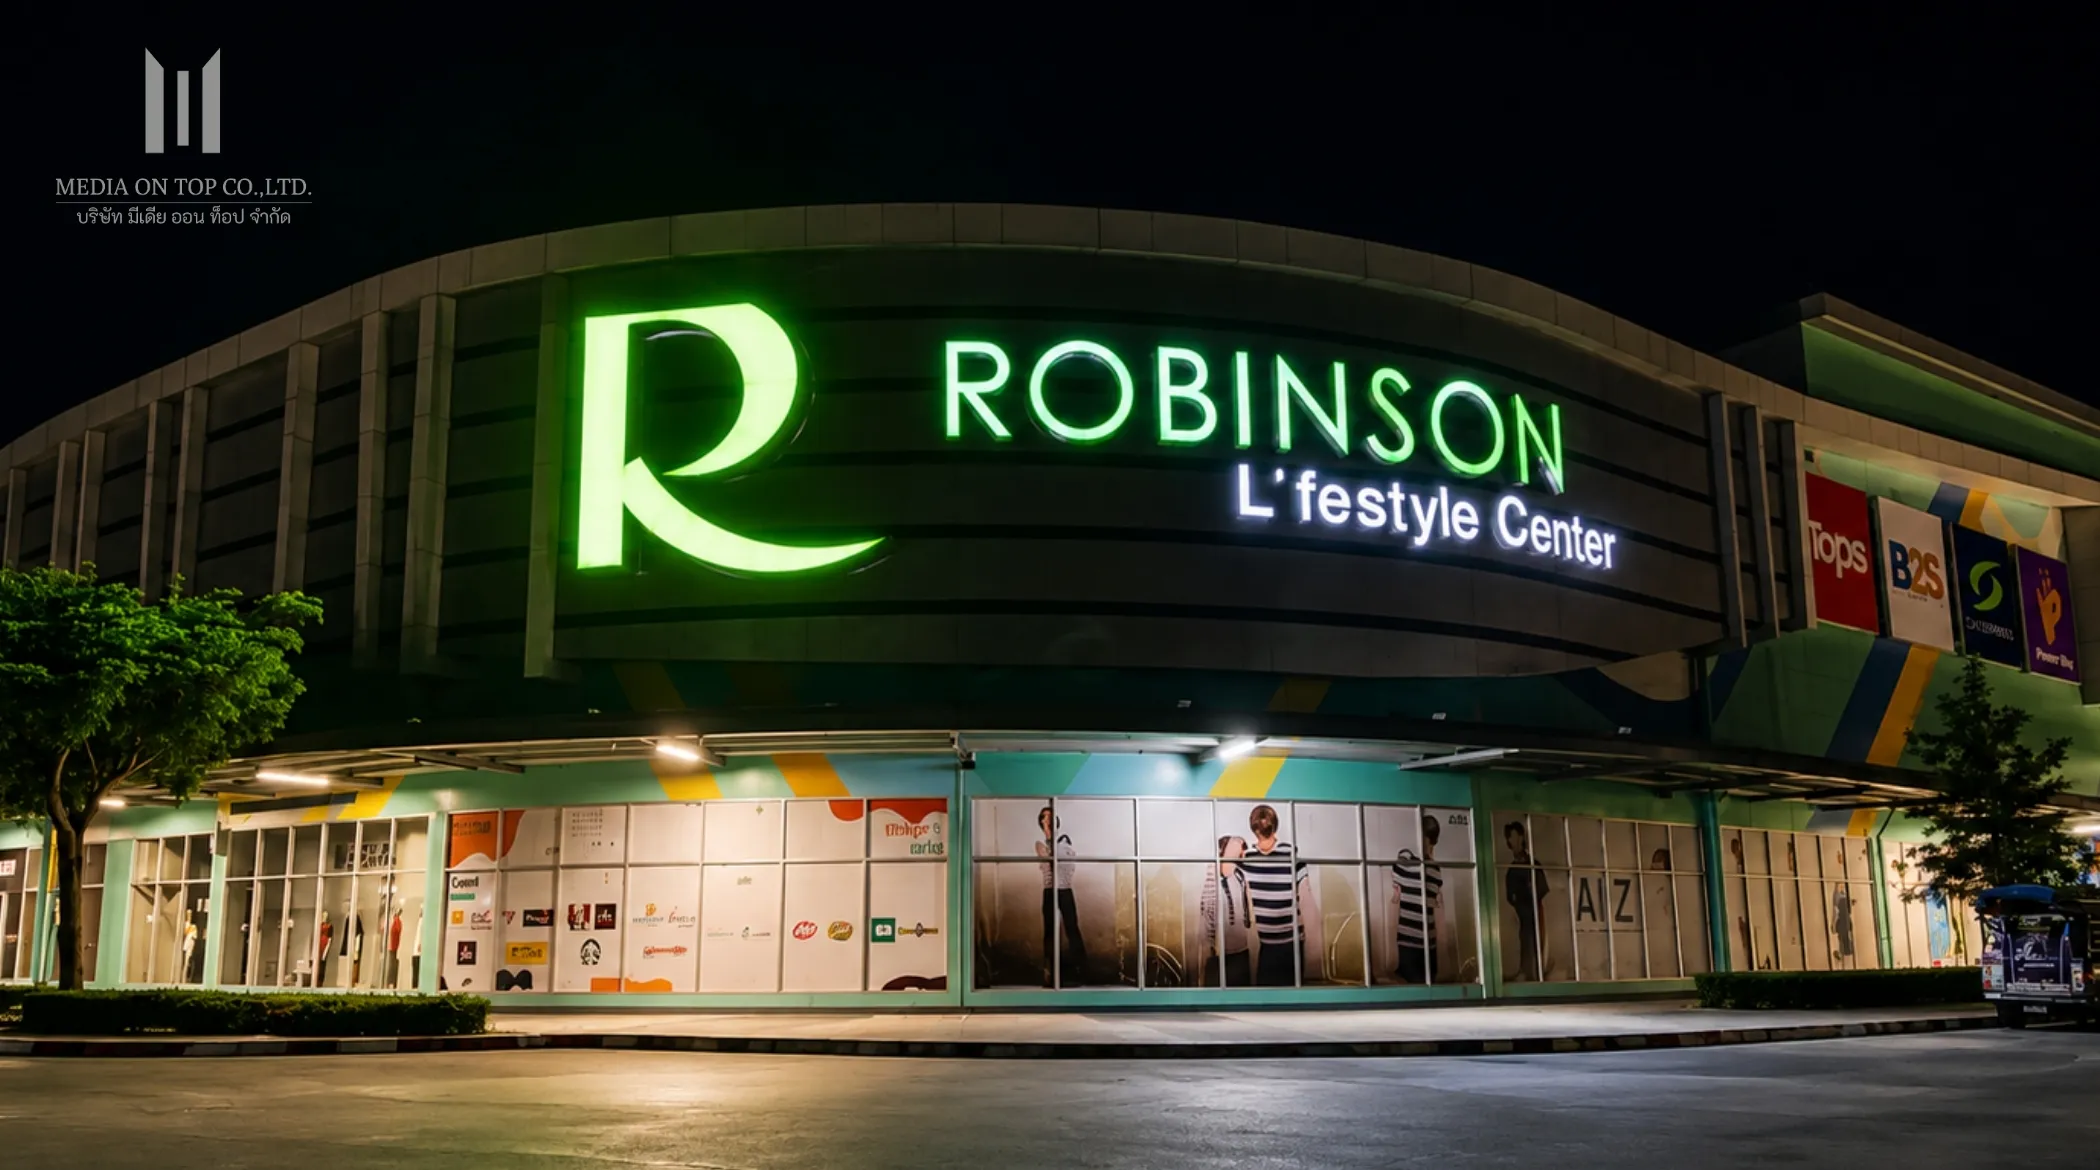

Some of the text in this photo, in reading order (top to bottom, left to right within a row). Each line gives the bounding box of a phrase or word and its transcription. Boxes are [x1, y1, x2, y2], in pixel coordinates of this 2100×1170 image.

[576, 302, 886, 573] R
[945, 340, 1564, 494] ROBINSON
[1496, 494, 1617, 570] Center
[1808, 519, 1868, 579] Tops
[1888, 538, 1945, 601] B2S
